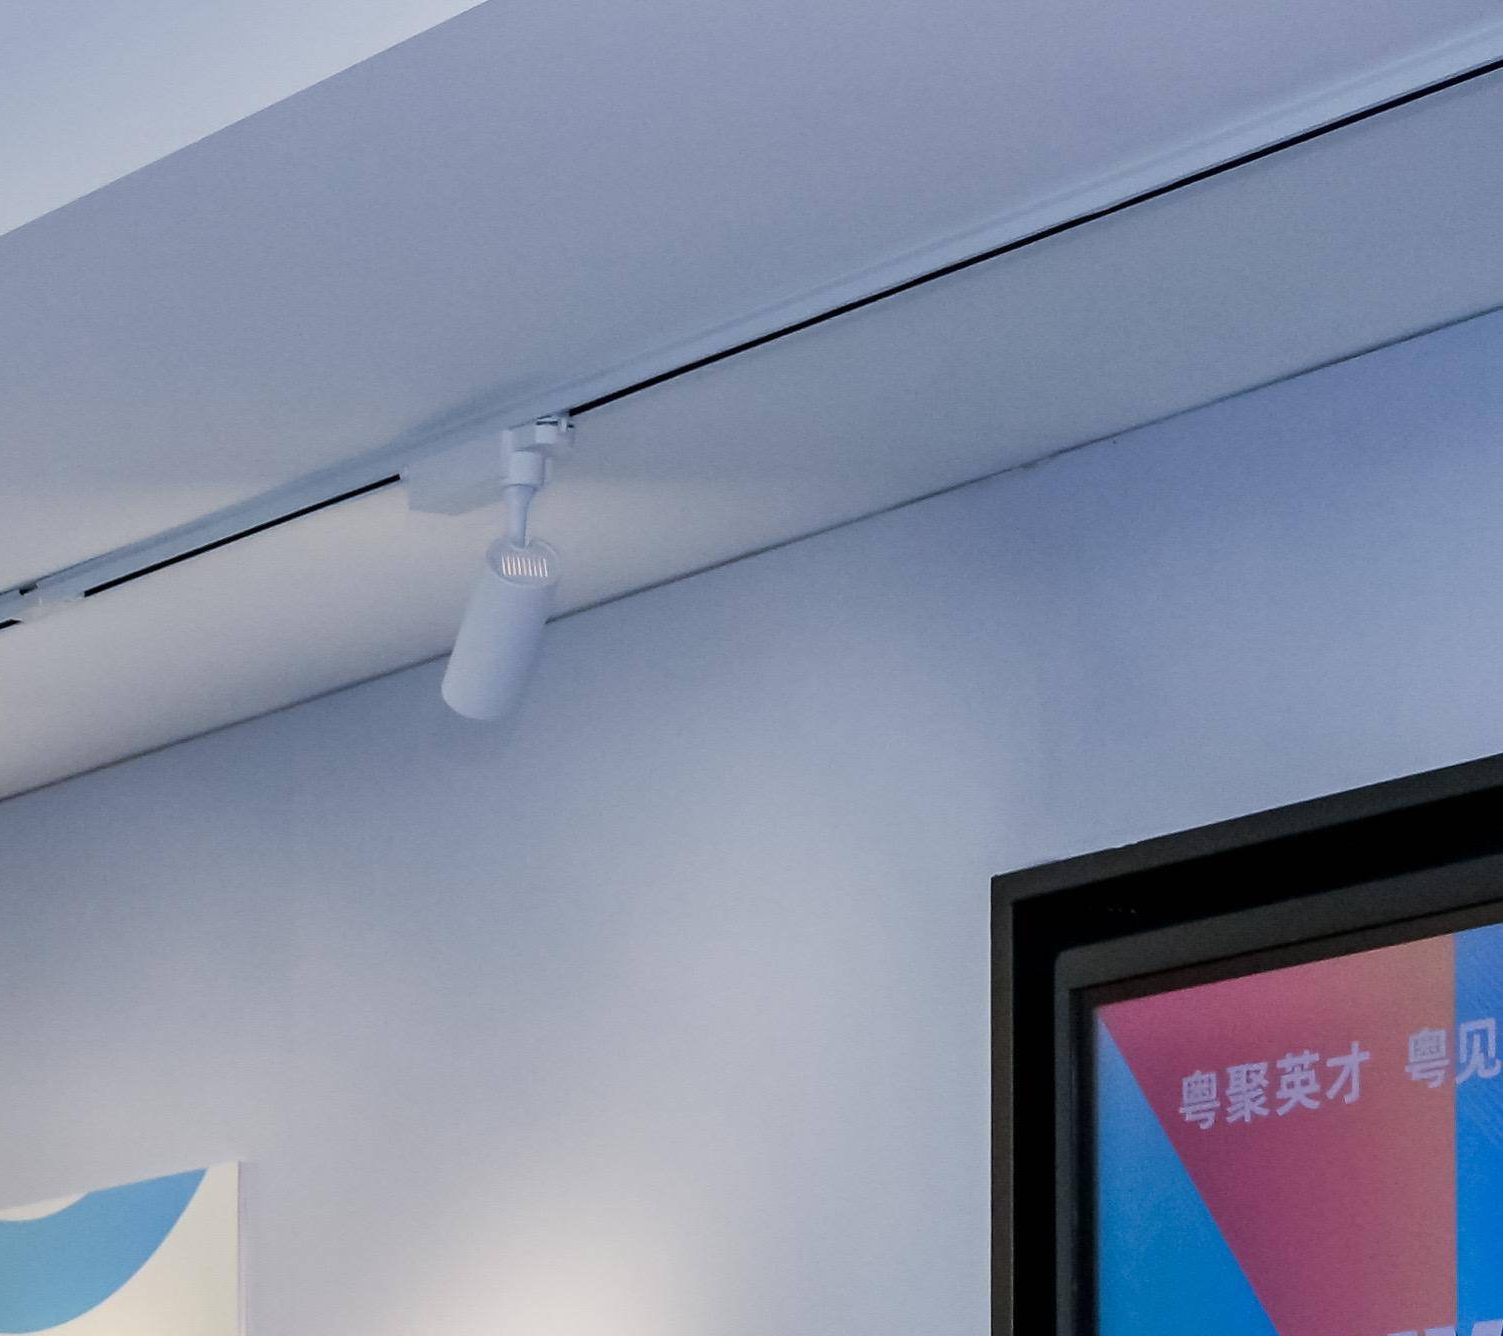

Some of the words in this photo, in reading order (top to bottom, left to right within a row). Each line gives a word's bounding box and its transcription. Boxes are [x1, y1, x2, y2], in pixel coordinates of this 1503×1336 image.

[1178, 1040, 1371, 1131] 粤聚英才
[1404, 1016, 1503, 1090] 粤见
